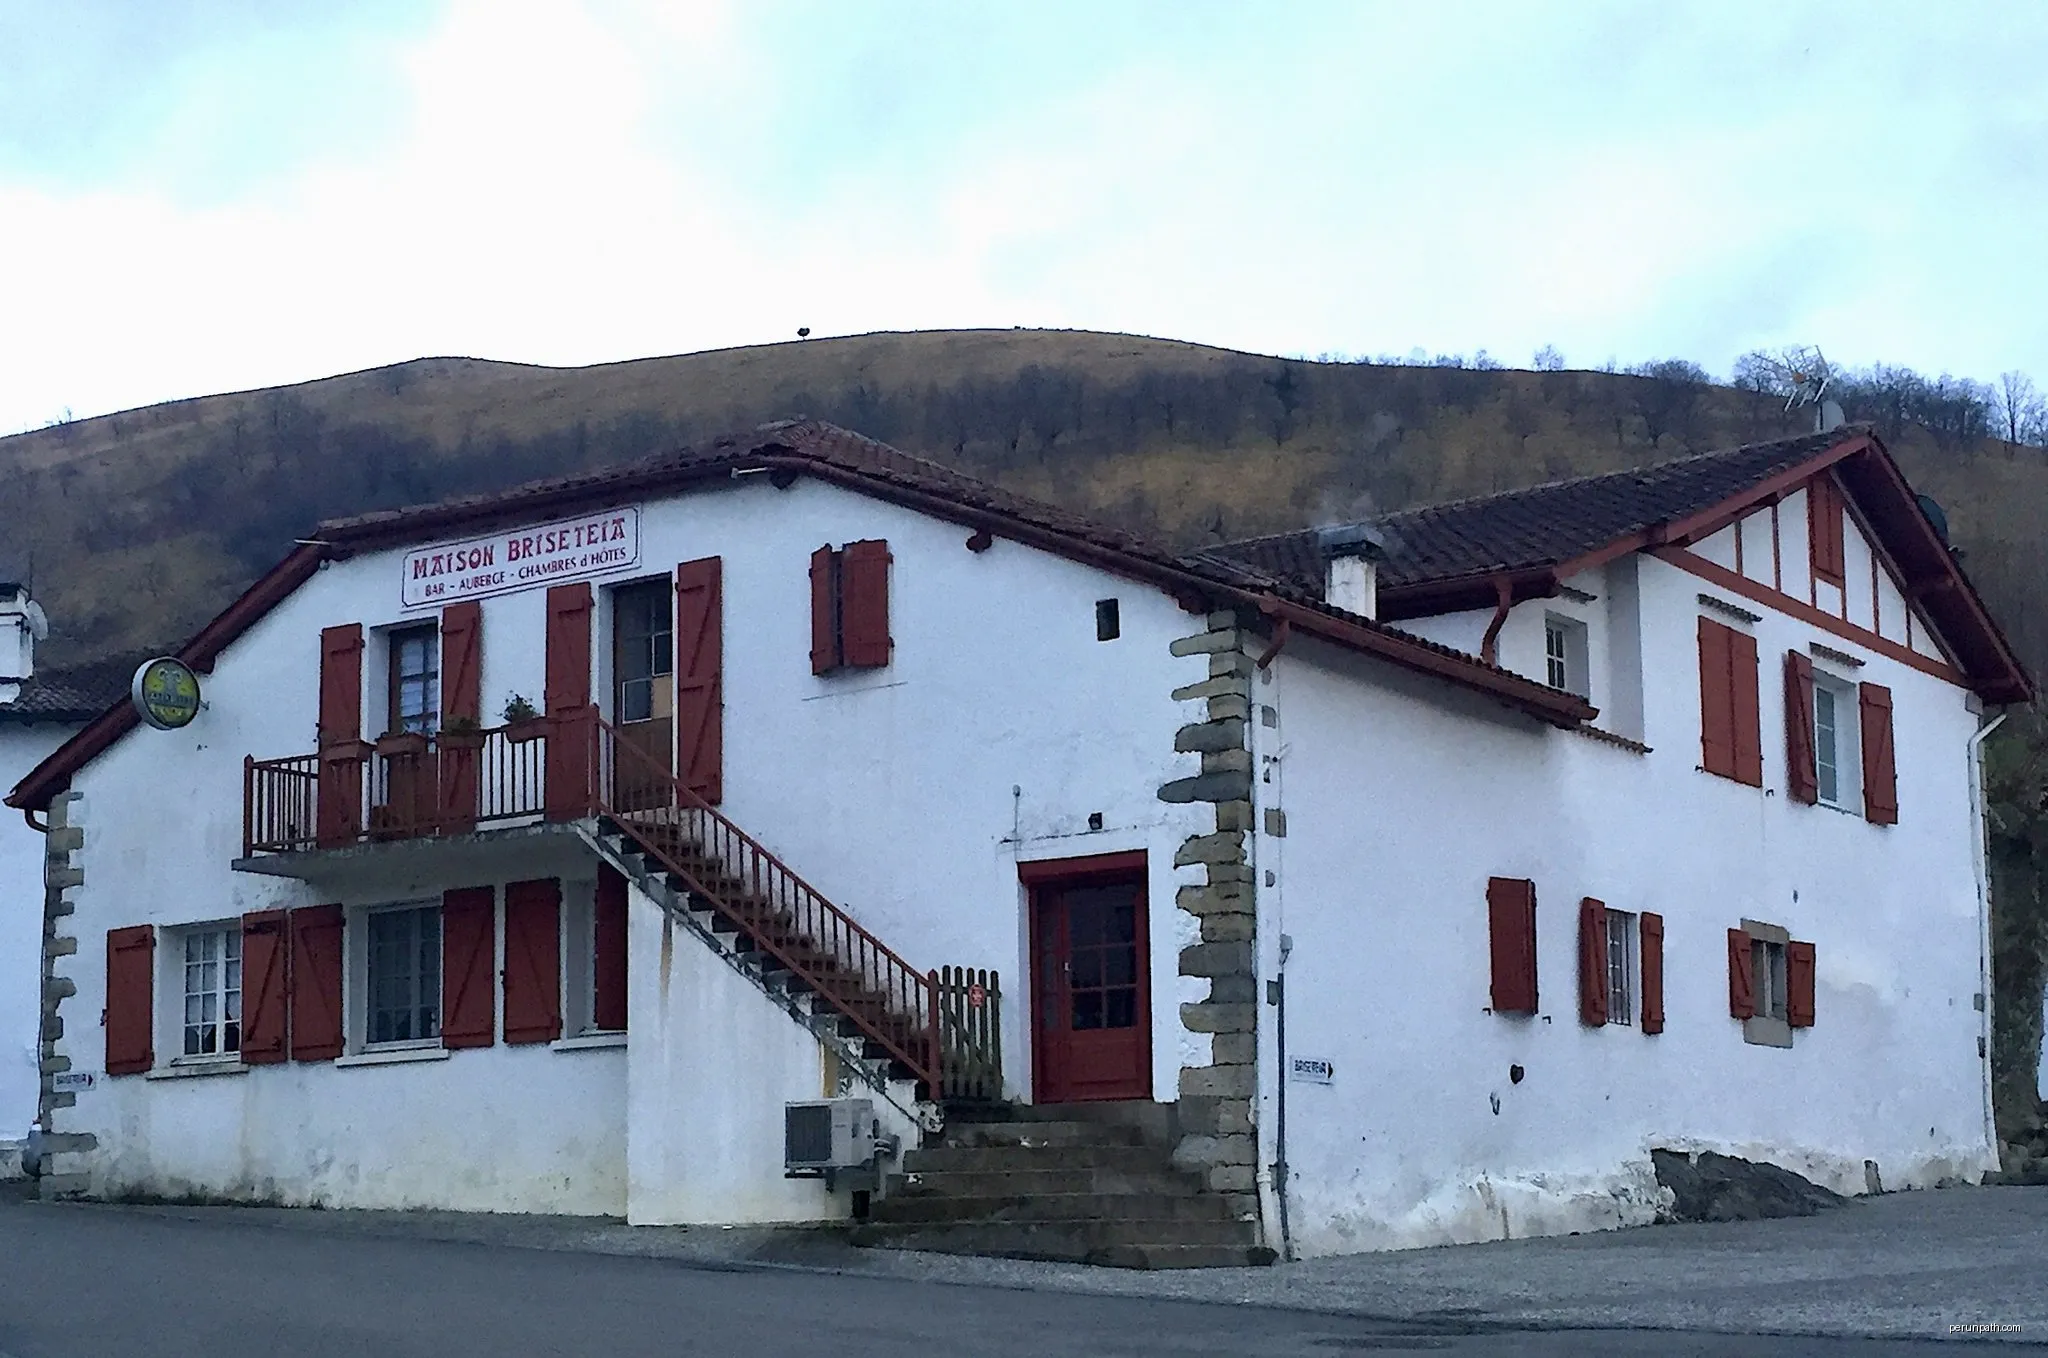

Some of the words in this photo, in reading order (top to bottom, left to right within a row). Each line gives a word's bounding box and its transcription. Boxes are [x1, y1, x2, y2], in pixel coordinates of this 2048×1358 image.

[425, 583, 445, 597] BAR
[459, 571, 505, 591] AUBERGE
[518, 557, 577, 579] CHAMBRES
